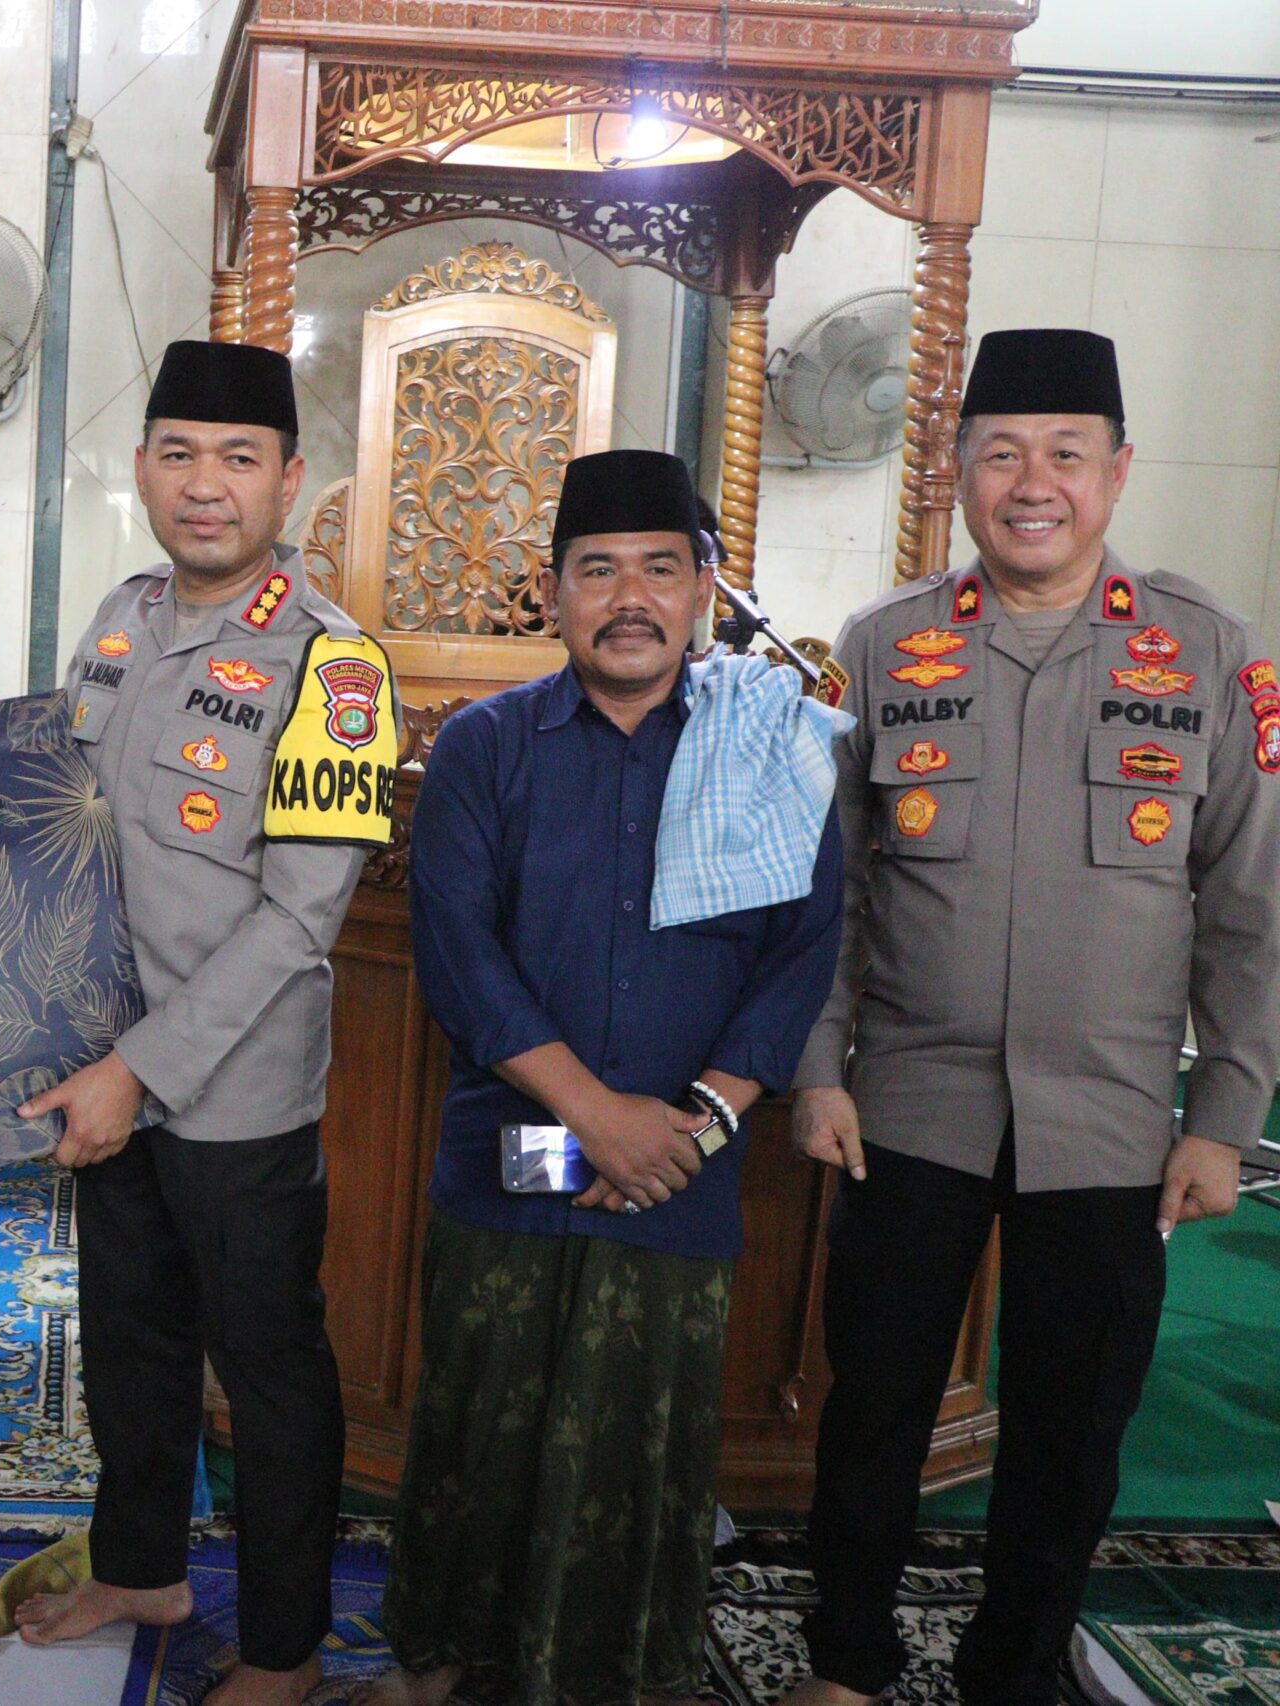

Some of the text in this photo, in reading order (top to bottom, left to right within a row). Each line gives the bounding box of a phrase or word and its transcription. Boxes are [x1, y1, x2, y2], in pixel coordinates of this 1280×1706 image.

[185, 688, 264, 733] POLRI
[881, 697, 974, 727] DALBY
[1101, 700, 1202, 735] POLRI
[272, 757, 396, 819] KA OPS RE
